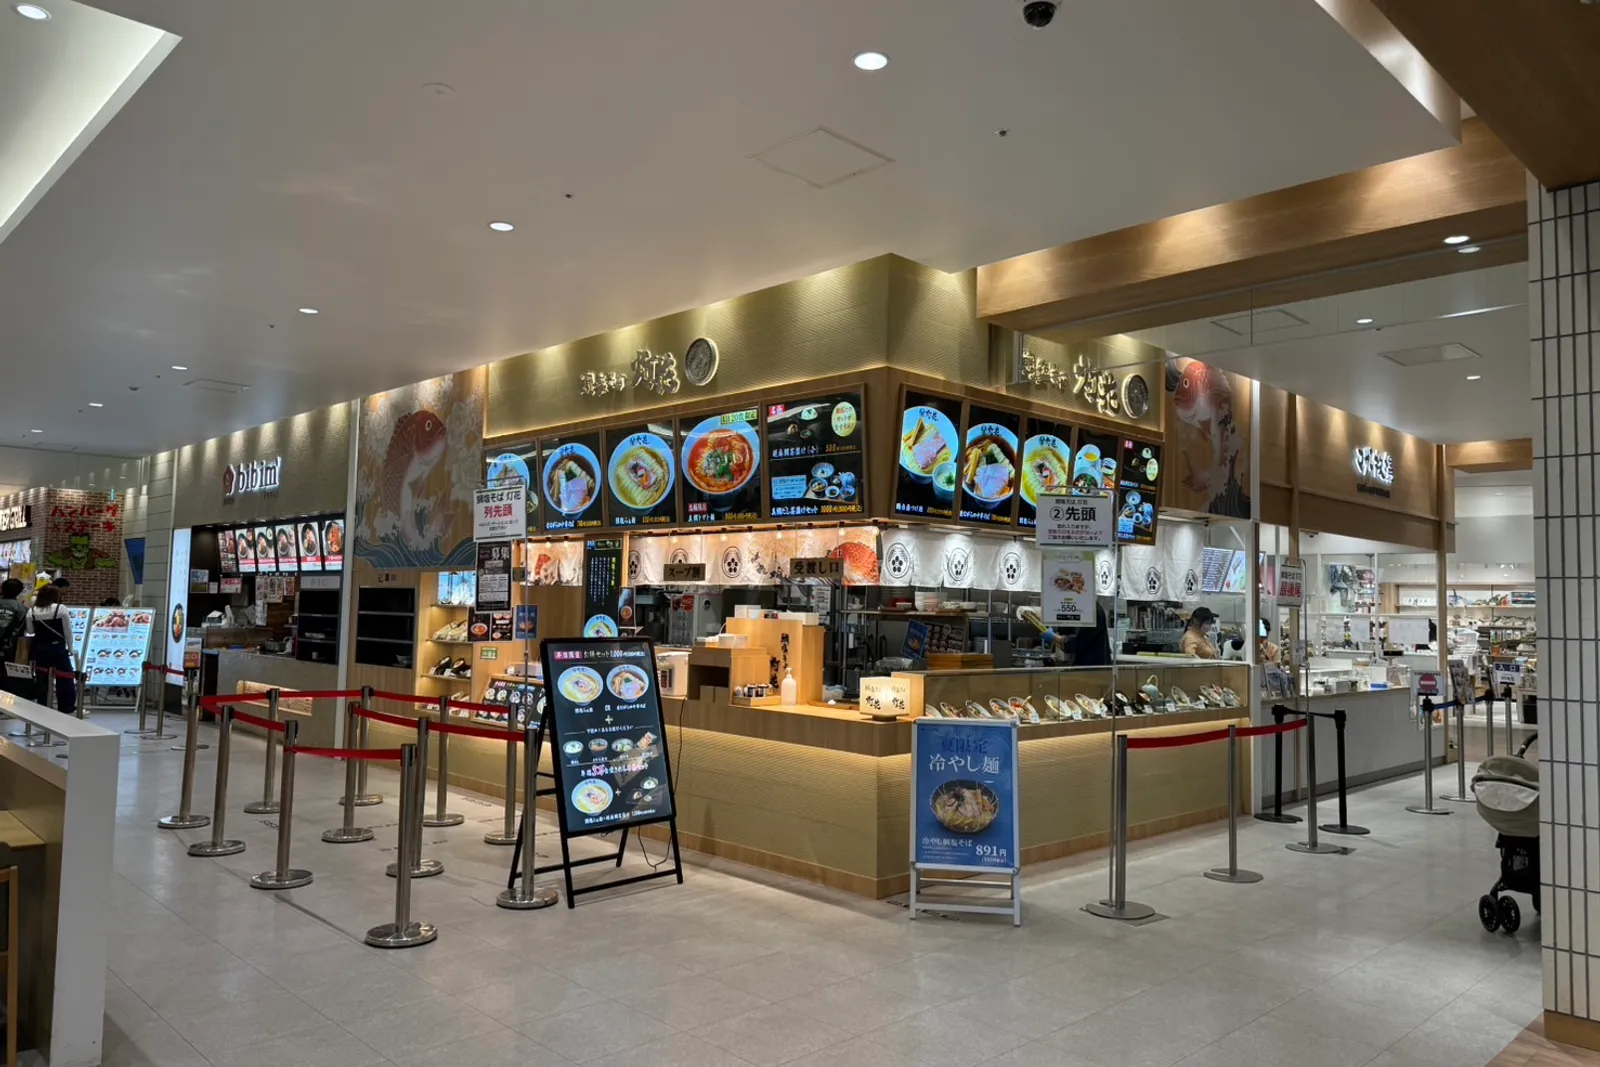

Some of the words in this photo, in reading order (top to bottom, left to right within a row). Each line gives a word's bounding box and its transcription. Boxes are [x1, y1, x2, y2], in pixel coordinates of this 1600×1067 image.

[506, 490, 521, 501] 灯花
[484, 503, 513, 518] 列先頭
[794, 561, 840, 575] 受渡し口
[1280, 581, 1302, 598] 最後尾
[1061, 605, 1076, 613] 550
[929, 754, 999, 774] 冷やし麺
[976, 845, 1008, 857] 891円
